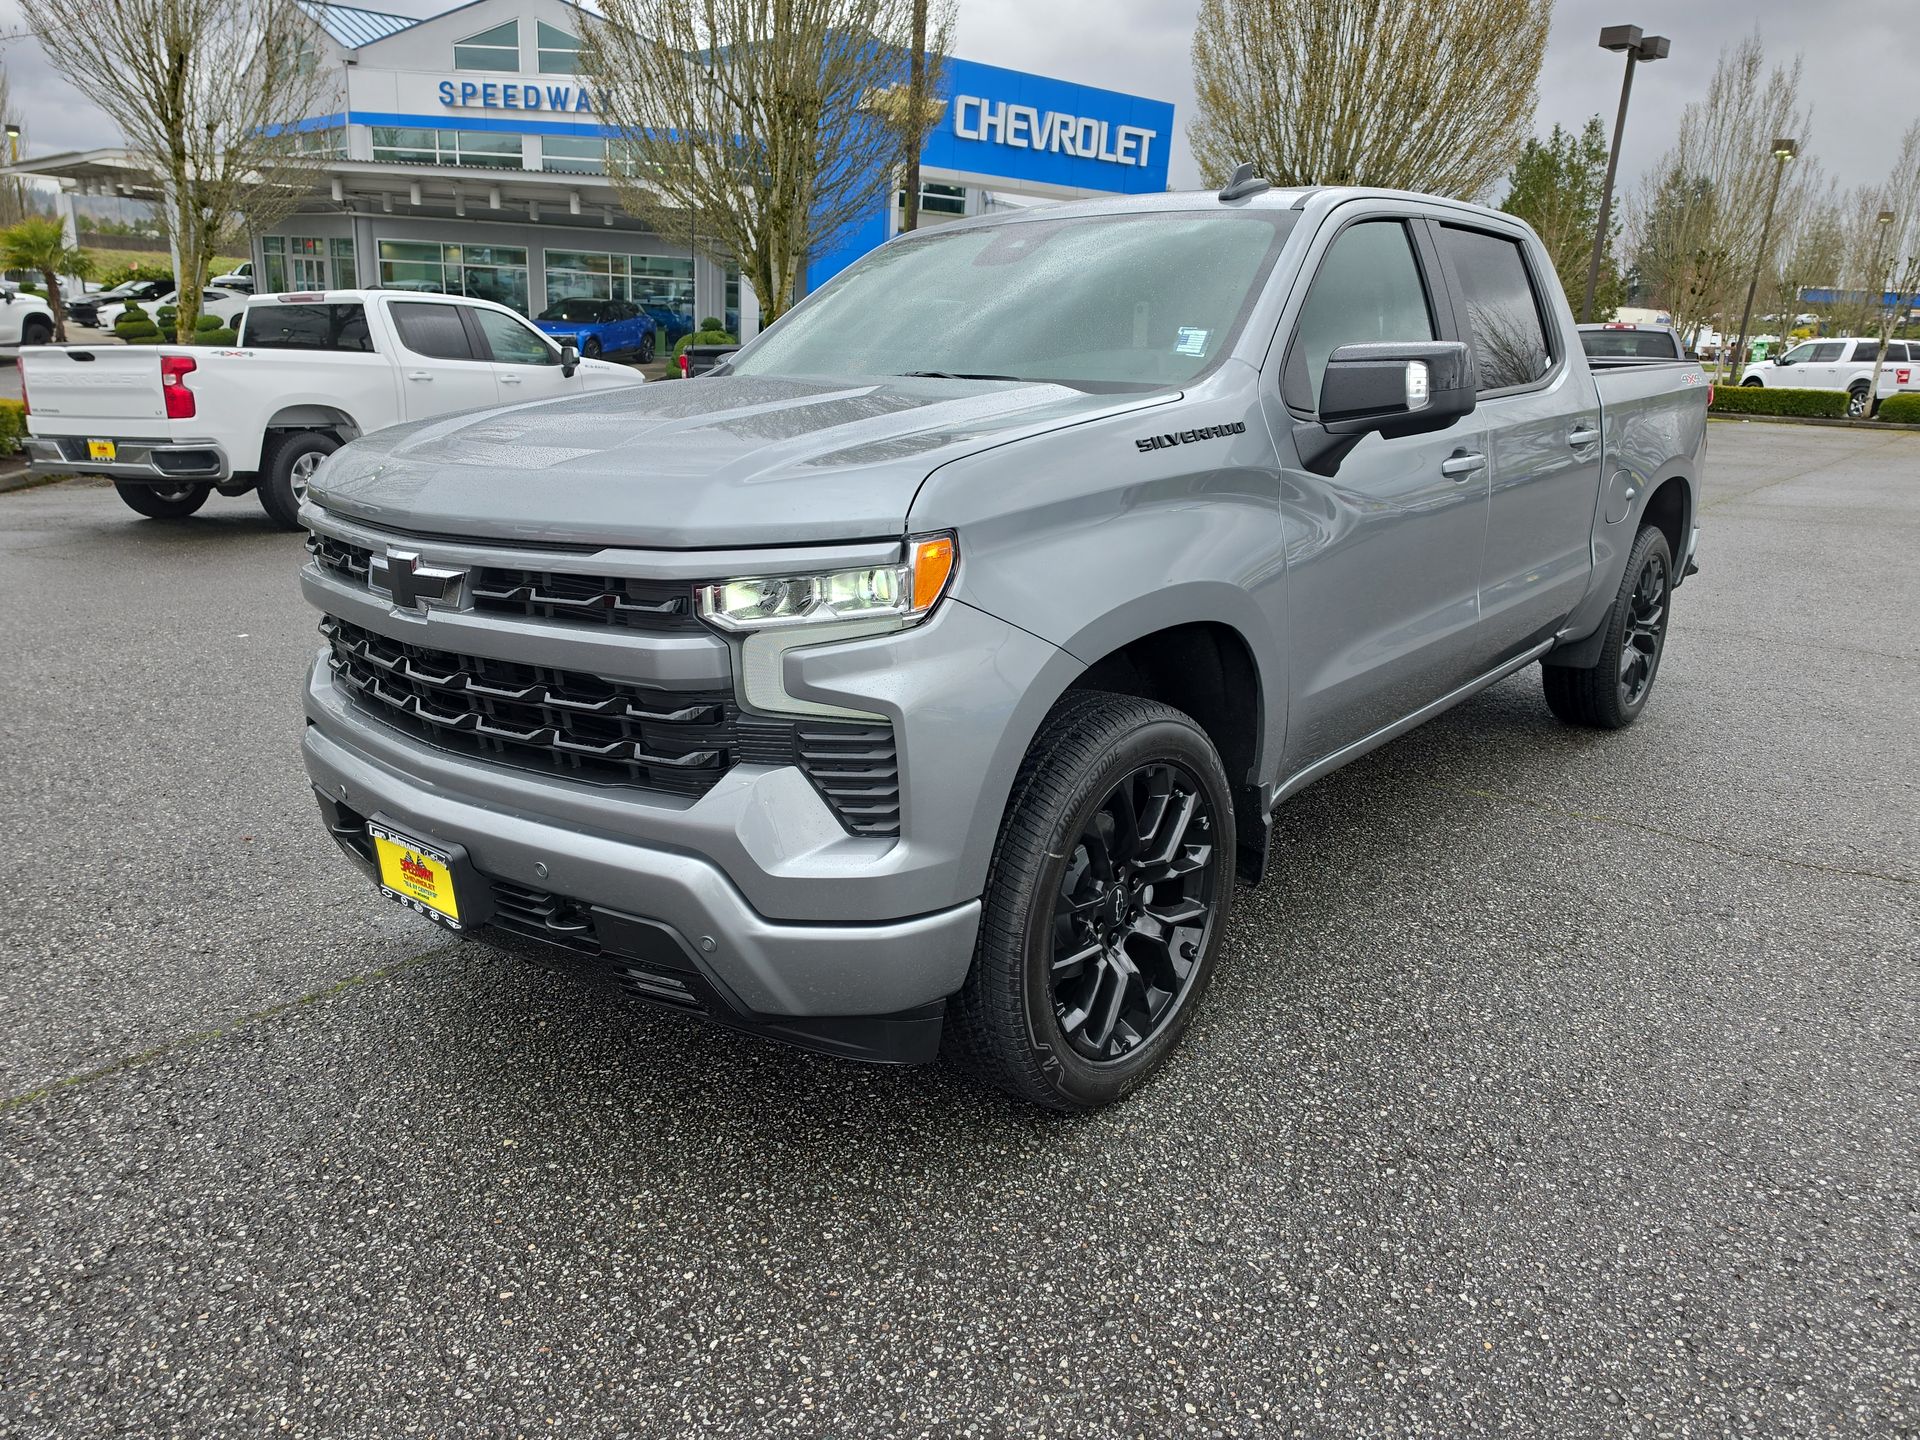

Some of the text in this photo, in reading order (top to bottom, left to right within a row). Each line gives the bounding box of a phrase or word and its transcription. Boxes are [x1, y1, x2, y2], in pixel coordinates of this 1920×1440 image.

[438, 80, 613, 113] SPEEDWAY
[954, 94, 1157, 167] CHEVROLET
[1135, 421, 1246, 452] SILVERADO
